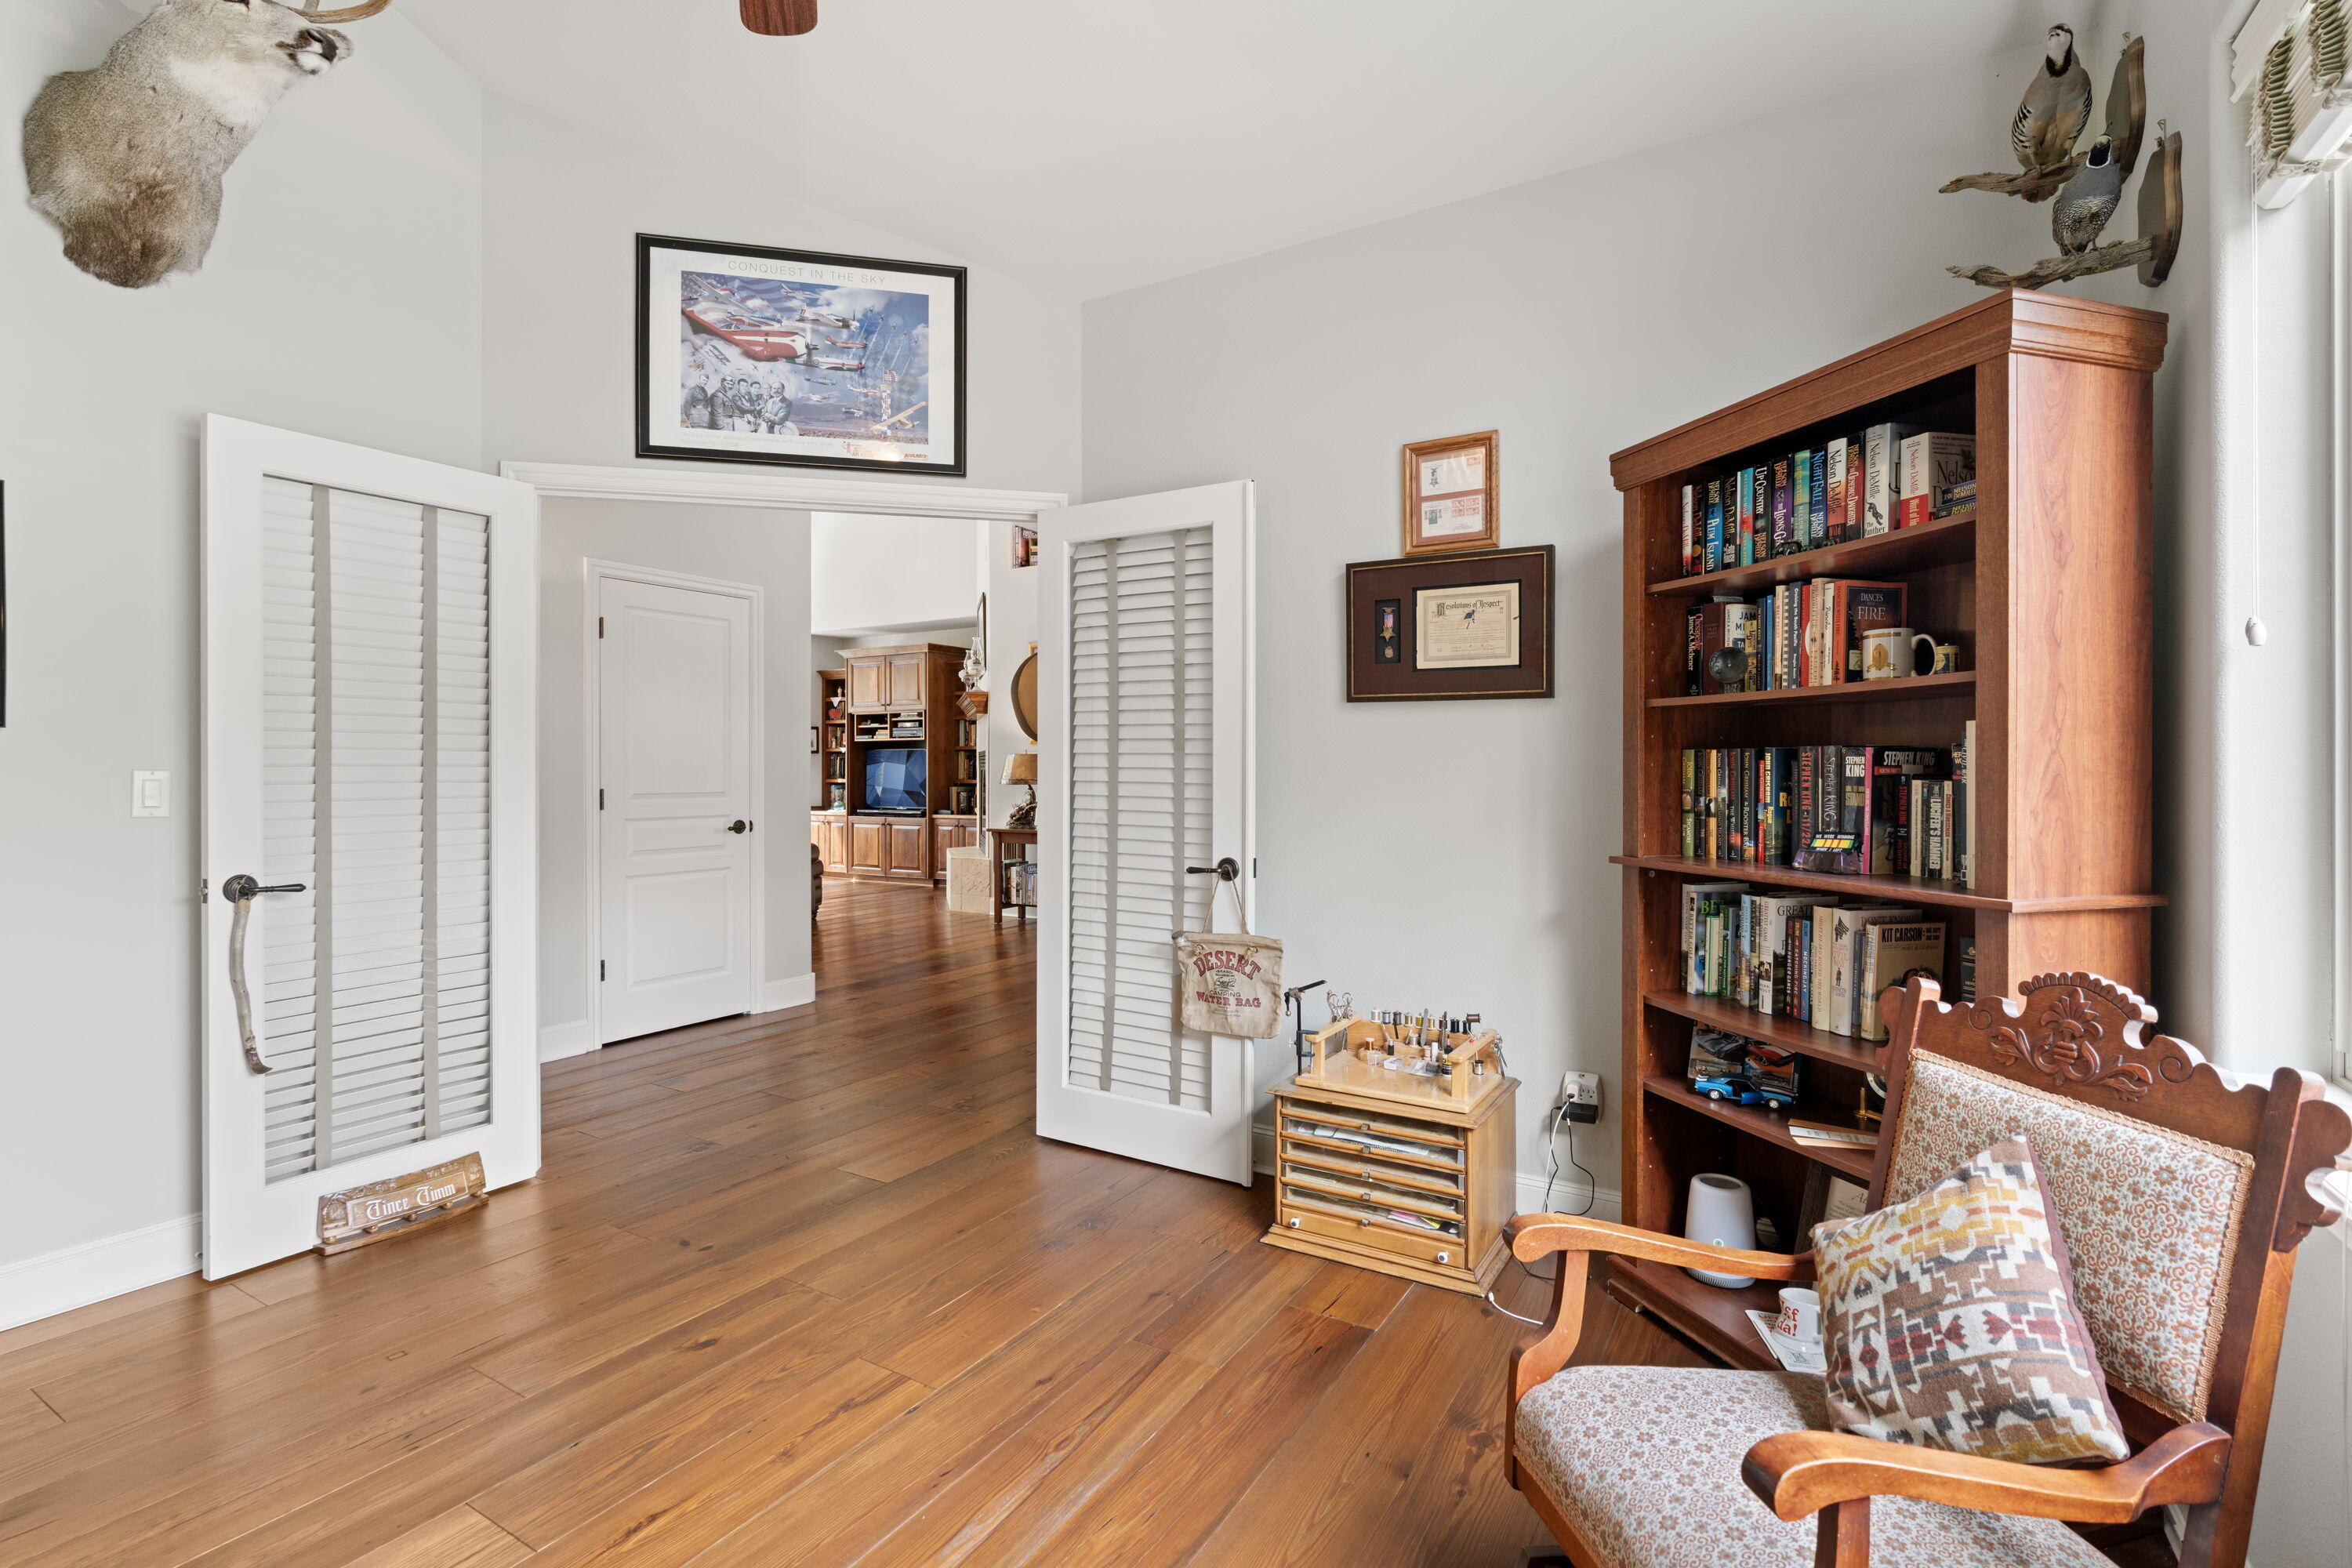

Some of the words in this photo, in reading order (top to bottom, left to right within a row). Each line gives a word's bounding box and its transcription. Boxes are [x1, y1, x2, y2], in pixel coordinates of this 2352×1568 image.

[728, 260, 804, 278] CONQUEST
[811, 269, 822, 279] IN
[829, 270, 854, 282] THE
[861, 274, 886, 285] SKY
[1829, 448, 1842, 480] Nelson
[1870, 441, 1880, 470] Nelson
[1911, 448, 1919, 470] Nelson
[1755, 466, 1767, 480] UP
[1869, 470, 1880, 499] DeMille
[1911, 471, 1919, 495] DeMille
[1693, 485, 1702, 511] Nelson
[1725, 477, 1736, 505] Nelson
[1755, 480, 1767, 514] COUNTRY
[1828, 480, 1842, 514] DeMille
[1847, 496, 1858, 526] DAUGHTER
[1909, 498, 1920, 513] Word
[1693, 511, 1702, 542] DeMille
[1707, 518, 1719, 539] PLUM
[1724, 506, 1736, 539] DeMille
[1864, 524, 1886, 537] Panther
[1707, 541, 1719, 571] ISLAND
[1860, 593, 1884, 602] DANCES
[1857, 606, 1887, 621] FIRE
[1695, 613, 1704, 650] Chesapeake
[1801, 752, 1812, 787] STEPHEN
[1845, 756, 1865, 764] STEPHEN
[1845, 764, 1865, 778] KING
[1883, 751, 1914, 766] STEPHEN
[1915, 751, 1936, 765] KING
[1824, 757, 1836, 791] STEPHEN
[1801, 790, 1812, 810] KING
[1823, 794, 1837, 821] KING
[1845, 793, 1865, 806] STAND
[1899, 786, 1907, 811] STEPHEN
[1898, 811, 1907, 825] KING
[1929, 798, 1941, 836] LUCIFER'S
[1929, 837, 1941, 870] HAMMER
[1882, 927, 1893, 942] KIT
[1193, 950, 1261, 980] DESERT
[1196, 991, 1231, 1006] WATER
[1235, 997, 1261, 1008] BAG
[1210, 989, 1241, 998] CAMPING
